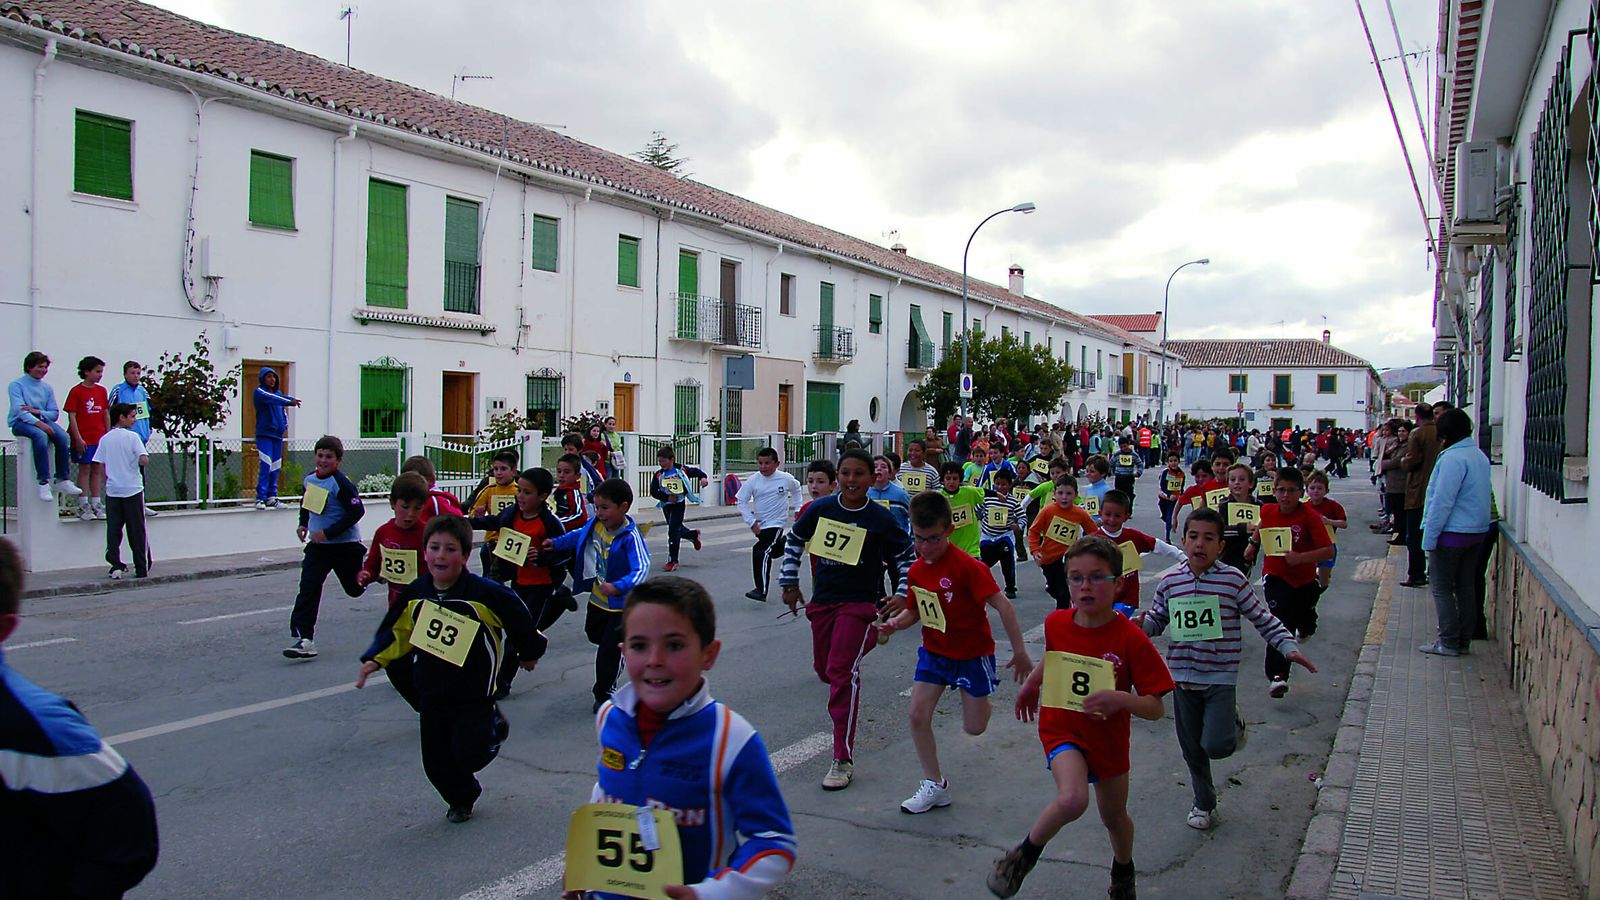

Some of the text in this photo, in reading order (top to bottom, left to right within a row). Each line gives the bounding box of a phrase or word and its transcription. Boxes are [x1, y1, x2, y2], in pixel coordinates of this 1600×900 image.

[666, 482, 678, 490] 63
[907, 477, 920, 486] 80
[1016, 492, 1026, 500] 76
[952, 510, 967, 523] 64
[1236, 509, 1253, 520] 46
[1053, 524, 1076, 540] 121
[504, 537, 523, 555] 91
[823, 531, 851, 551] 97
[1275, 534, 1282, 548] 1
[384, 557, 406, 574] 23
[920, 599, 938, 619] 11
[1174, 608, 1215, 629] 184
[426, 618, 459, 647] 93
[1071, 671, 1090, 696] 8
[597, 828, 655, 873] 55
